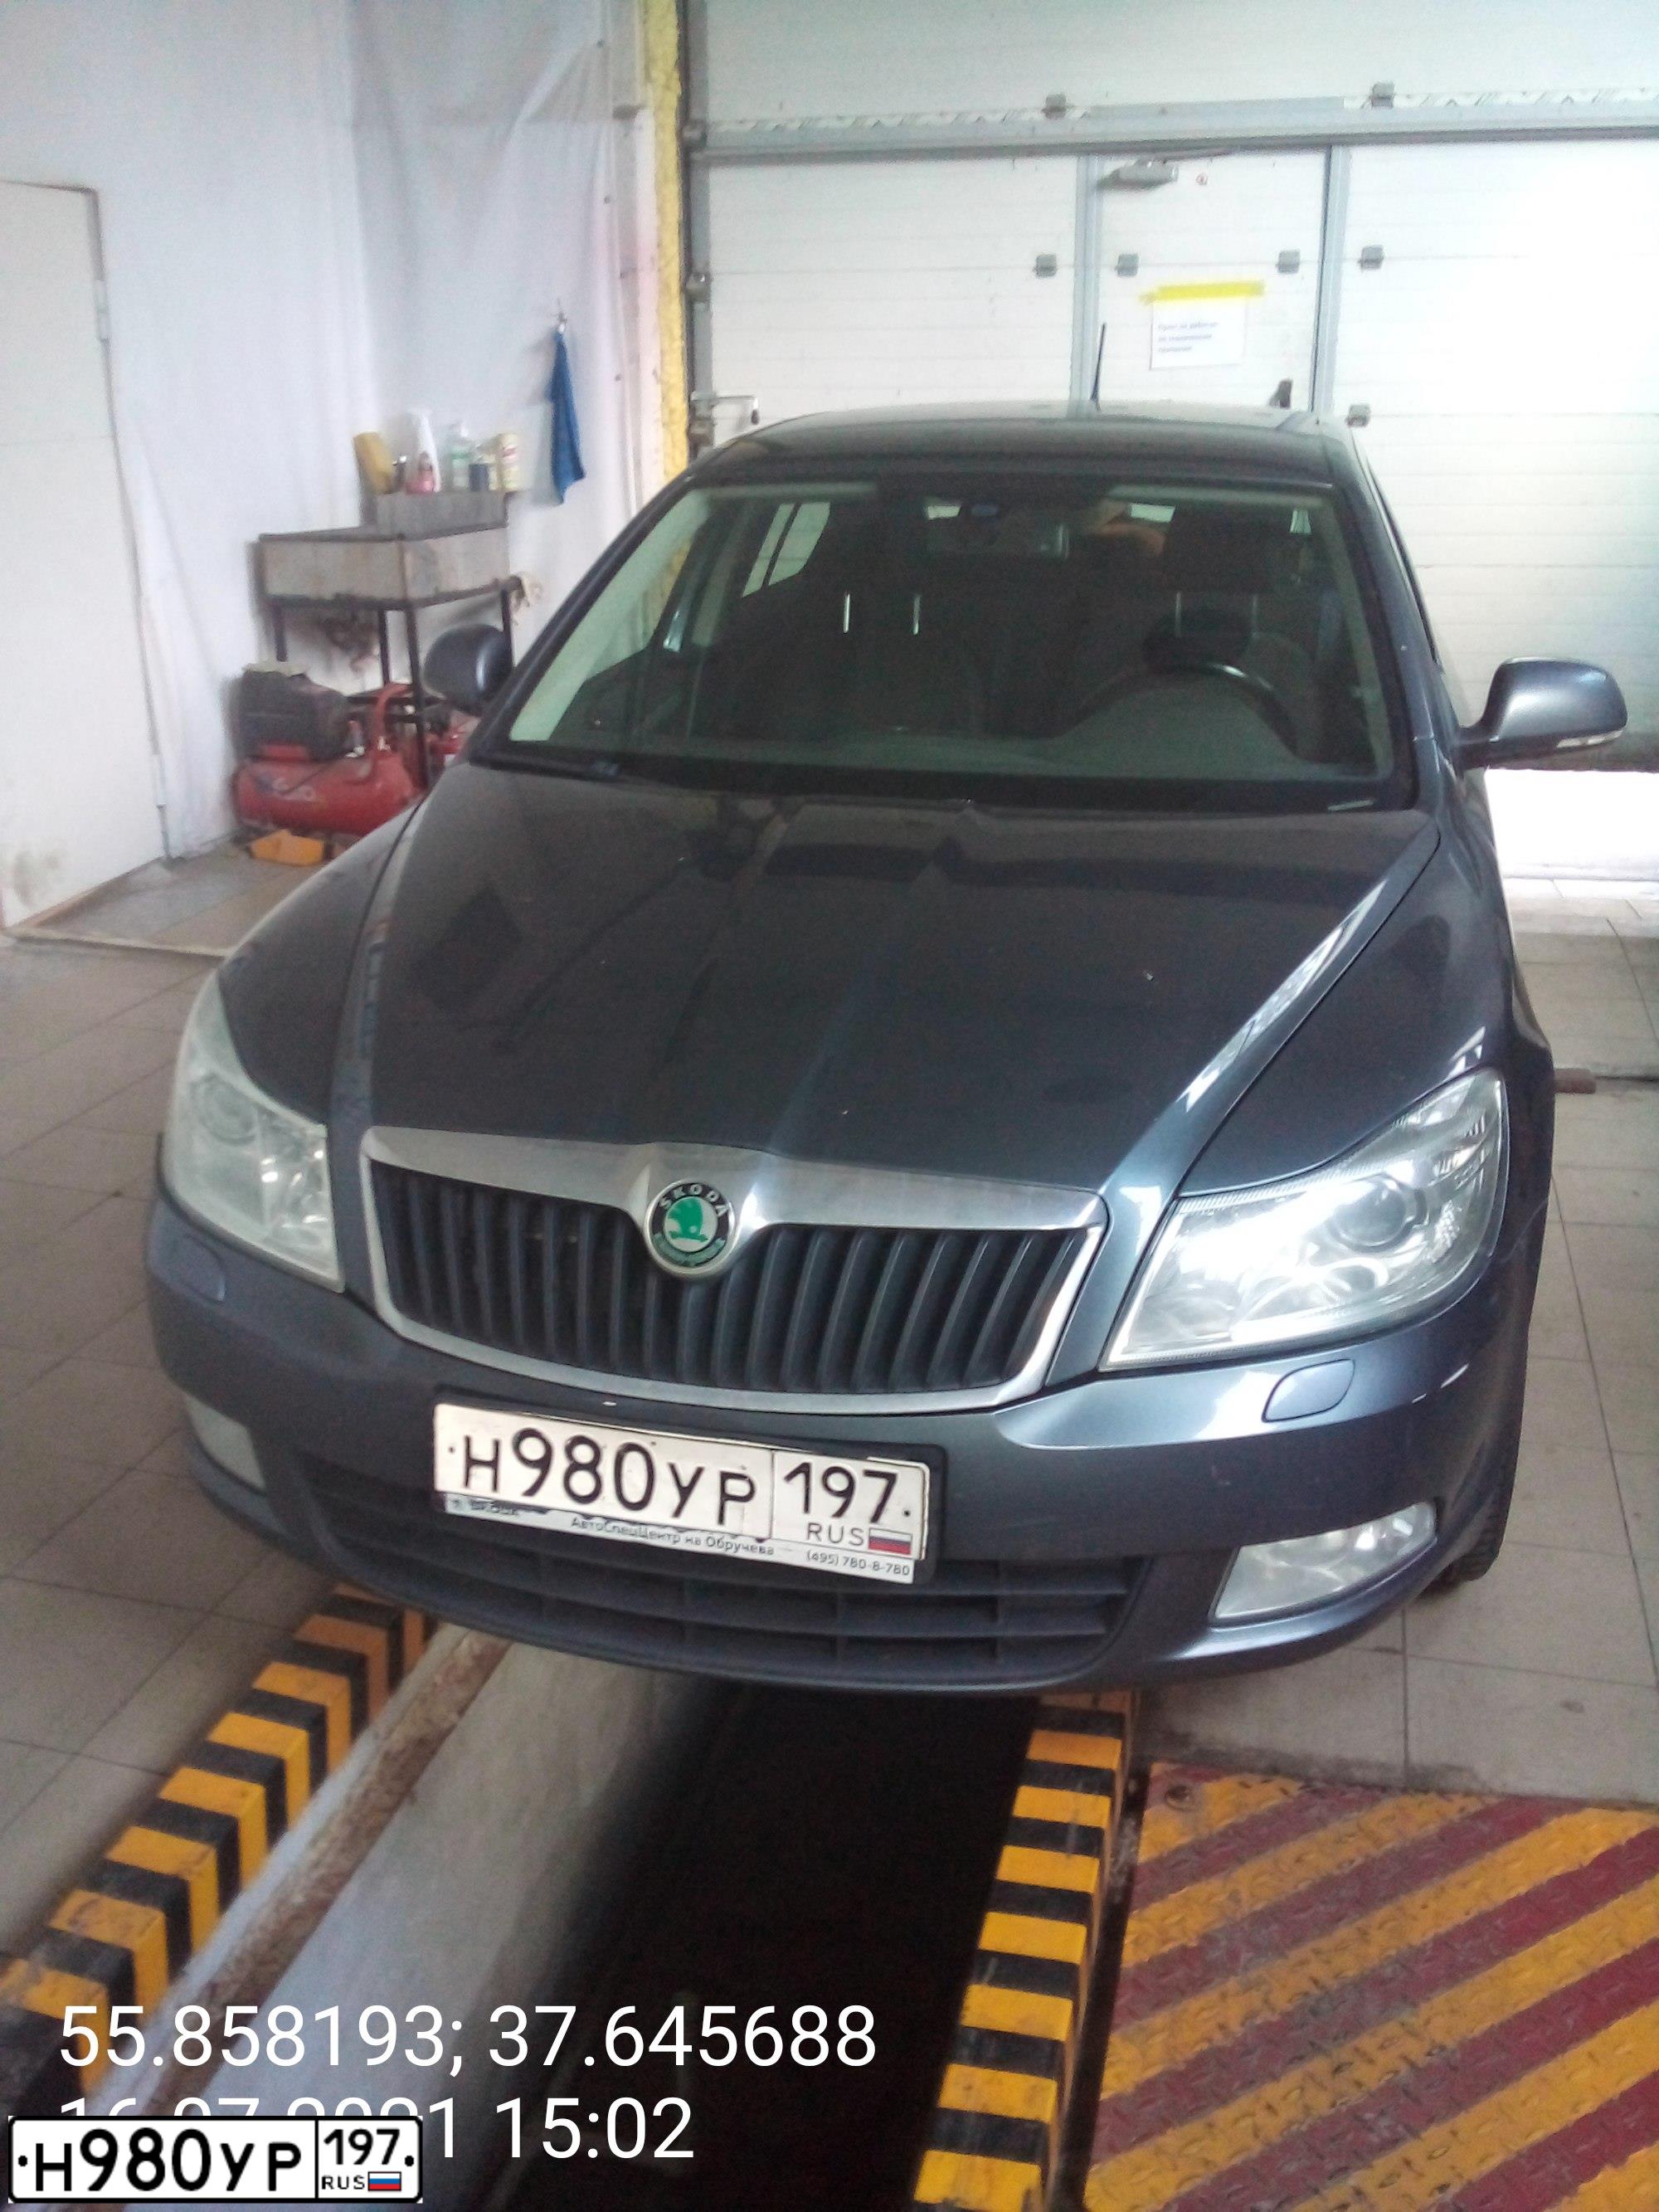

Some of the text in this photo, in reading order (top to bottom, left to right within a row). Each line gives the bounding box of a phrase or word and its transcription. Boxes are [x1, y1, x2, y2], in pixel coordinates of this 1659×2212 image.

[463, 1427, 899, 1527] Н980УР 197
[706, 1535, 775, 1557] Обручева
[806, 1522, 864, 1547] RUS
[806, 1549, 839, 1566] (495)
